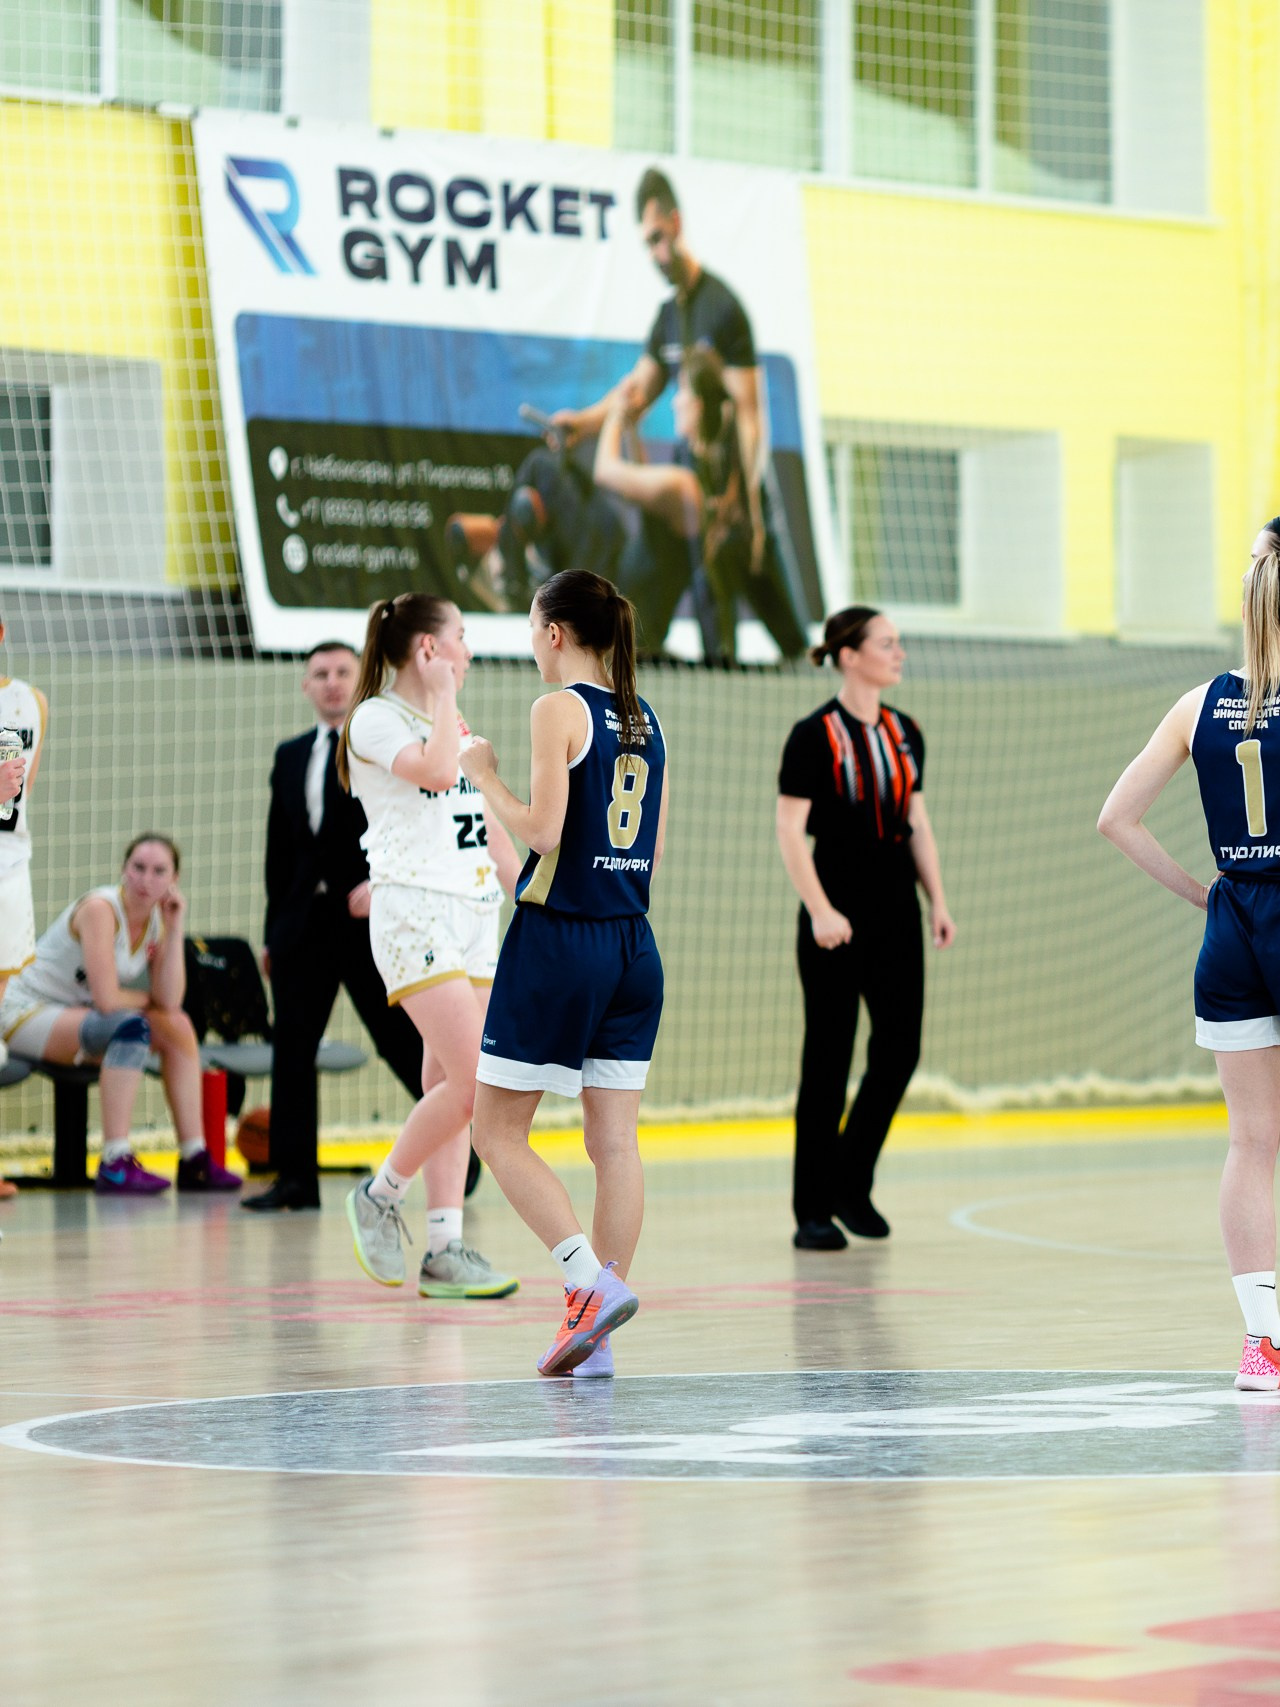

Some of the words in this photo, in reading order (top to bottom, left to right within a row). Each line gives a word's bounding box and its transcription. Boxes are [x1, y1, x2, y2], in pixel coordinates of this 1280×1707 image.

[337, 165, 617, 240] ROCKET
[342, 227, 499, 291] GYM
[607, 753, 649, 849] 8
[1235, 739, 1267, 837] 1
